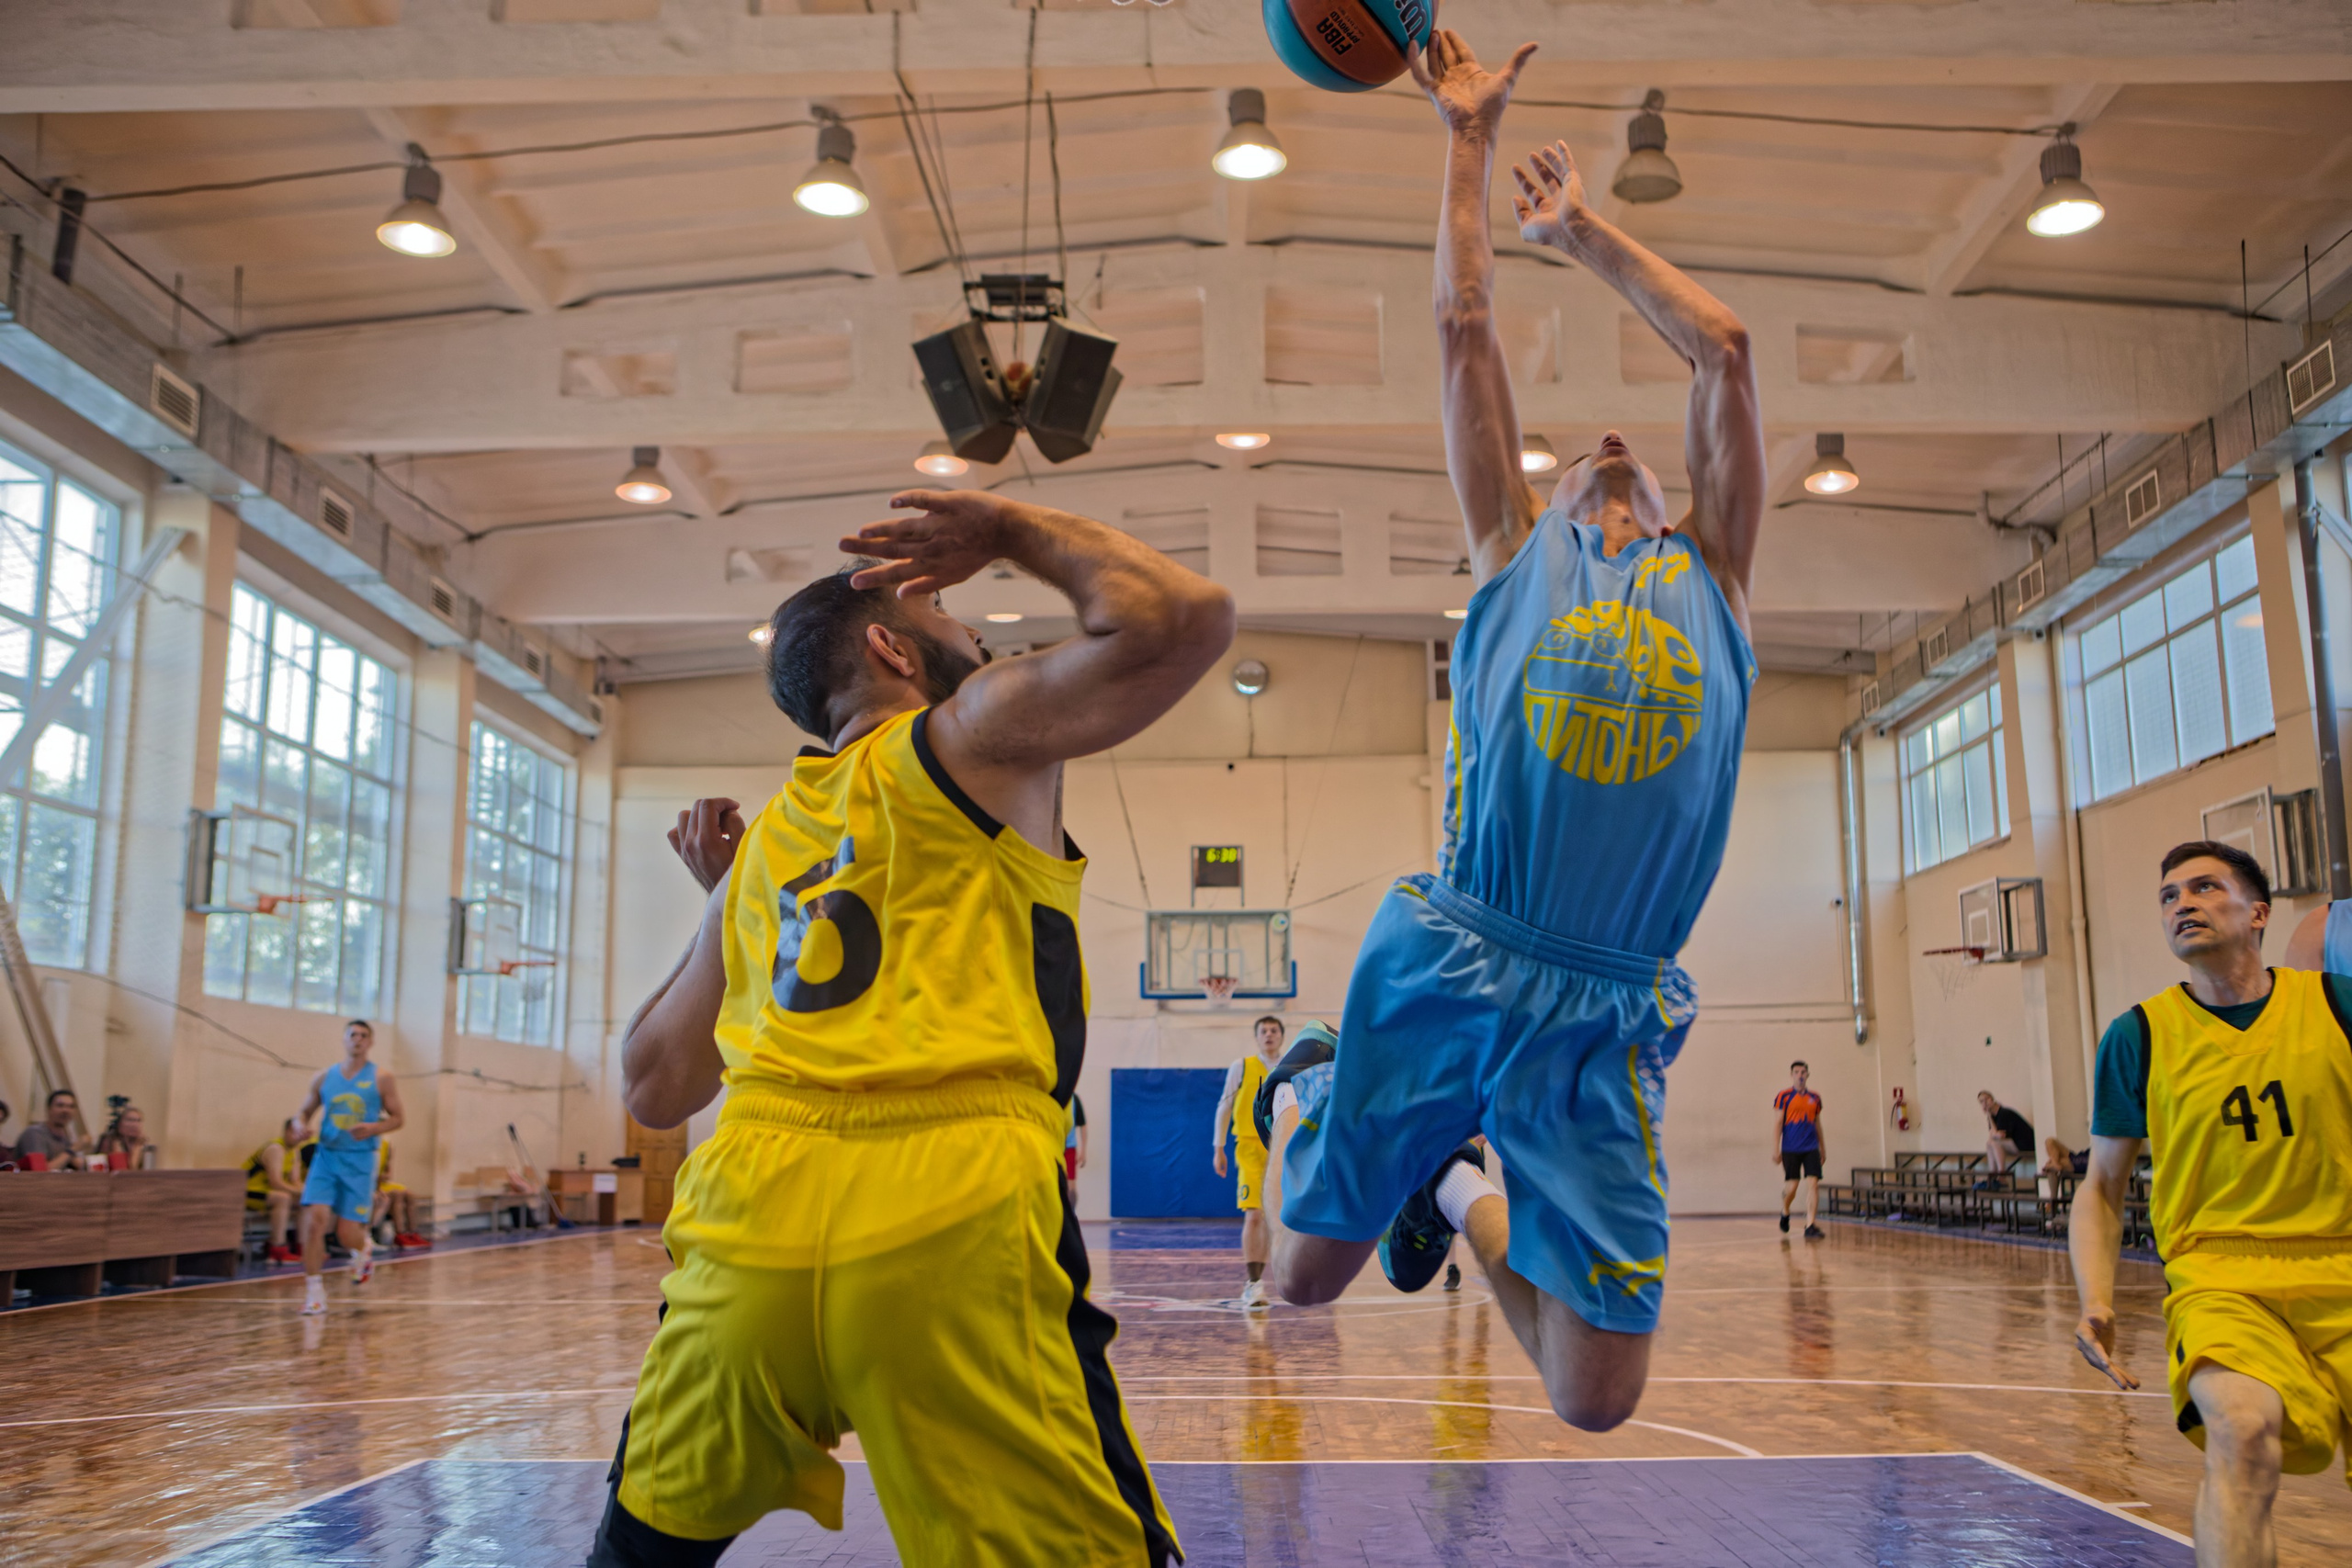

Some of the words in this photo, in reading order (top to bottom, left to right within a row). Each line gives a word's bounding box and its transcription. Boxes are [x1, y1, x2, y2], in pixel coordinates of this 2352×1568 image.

[1316, 17, 1352, 56] FIBA
[1329, 10, 1361, 44] APPROVED
[1523, 691, 1702, 785] ПИТОНЫ
[772, 836, 882, 1013] 6
[2220, 1079, 2295, 1142] 41
